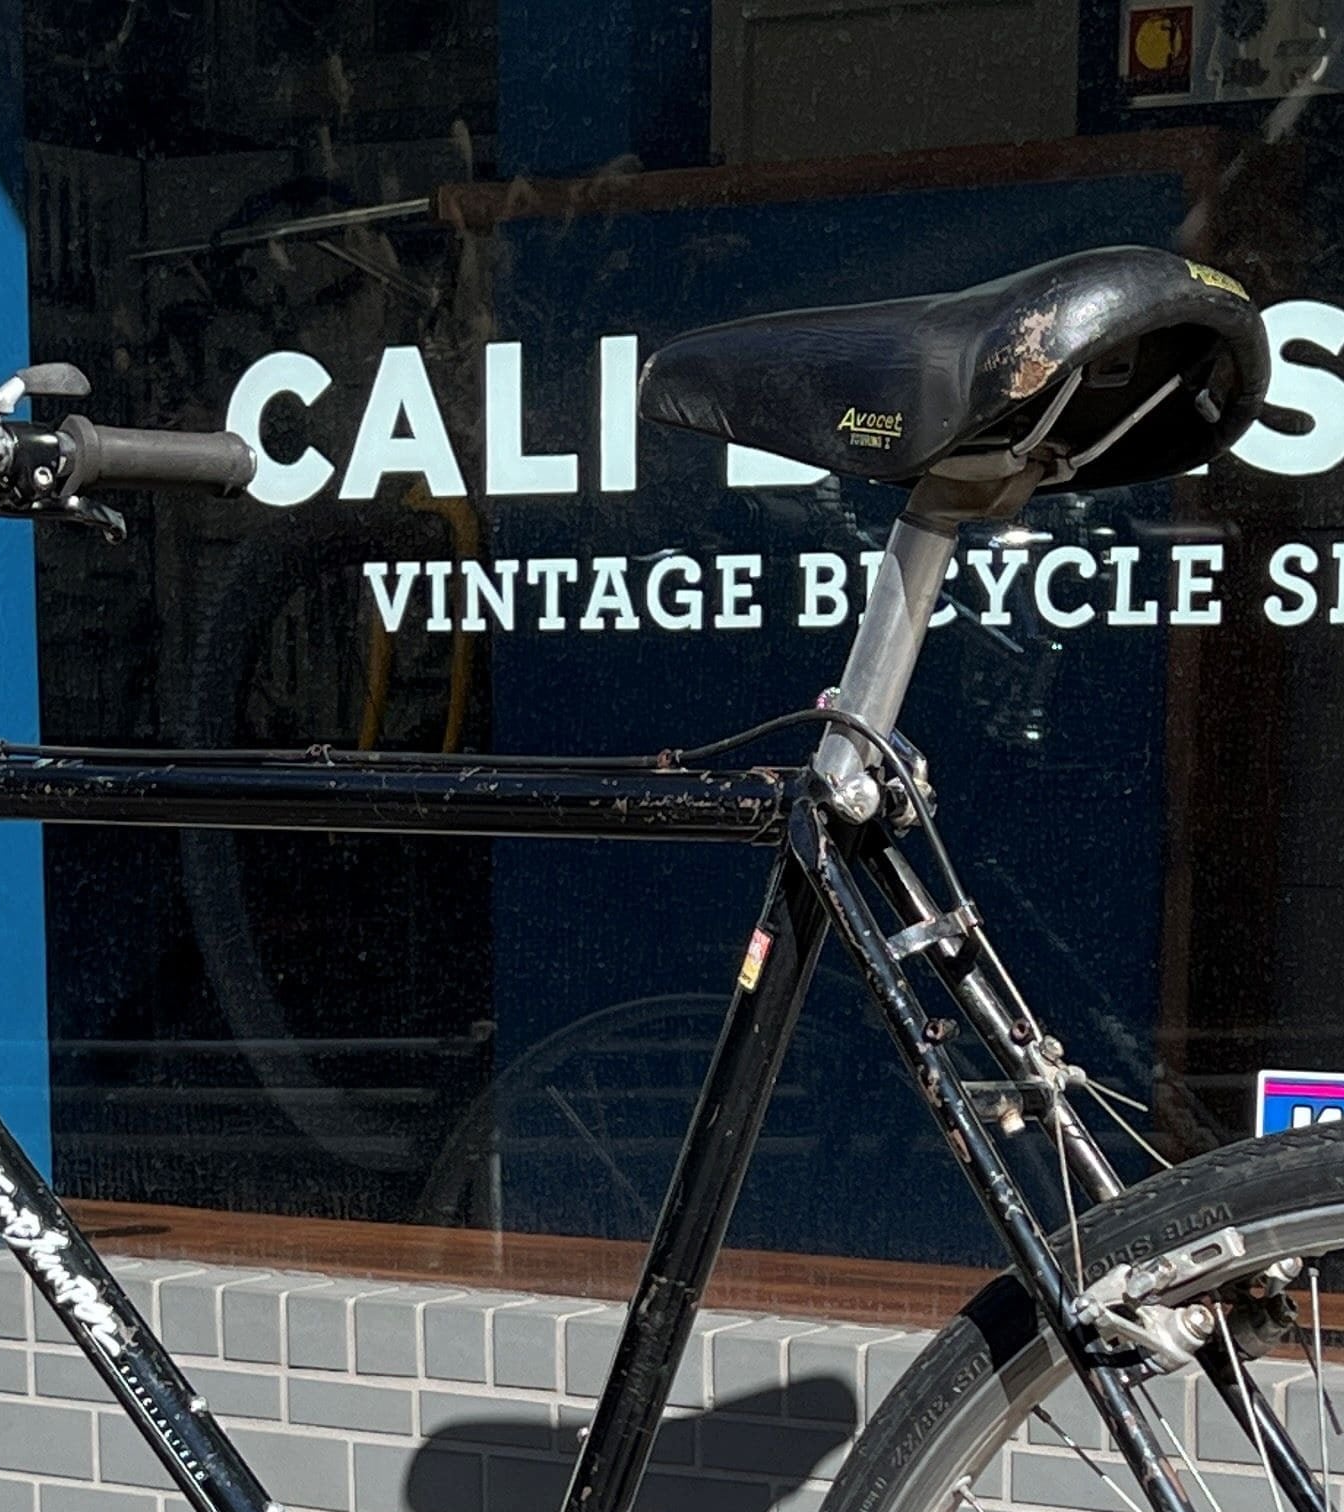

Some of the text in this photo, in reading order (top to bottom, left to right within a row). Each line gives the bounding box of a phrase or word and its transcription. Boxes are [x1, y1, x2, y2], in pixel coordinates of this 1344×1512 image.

[225, 336, 638, 507] CALI
[836, 406, 903, 436] Avocet
[363, 554, 762, 633] VINTAGE
[798, 546, 1224, 628] BYCLE
[119, 1363, 208, 1482] SPECIALIZED
